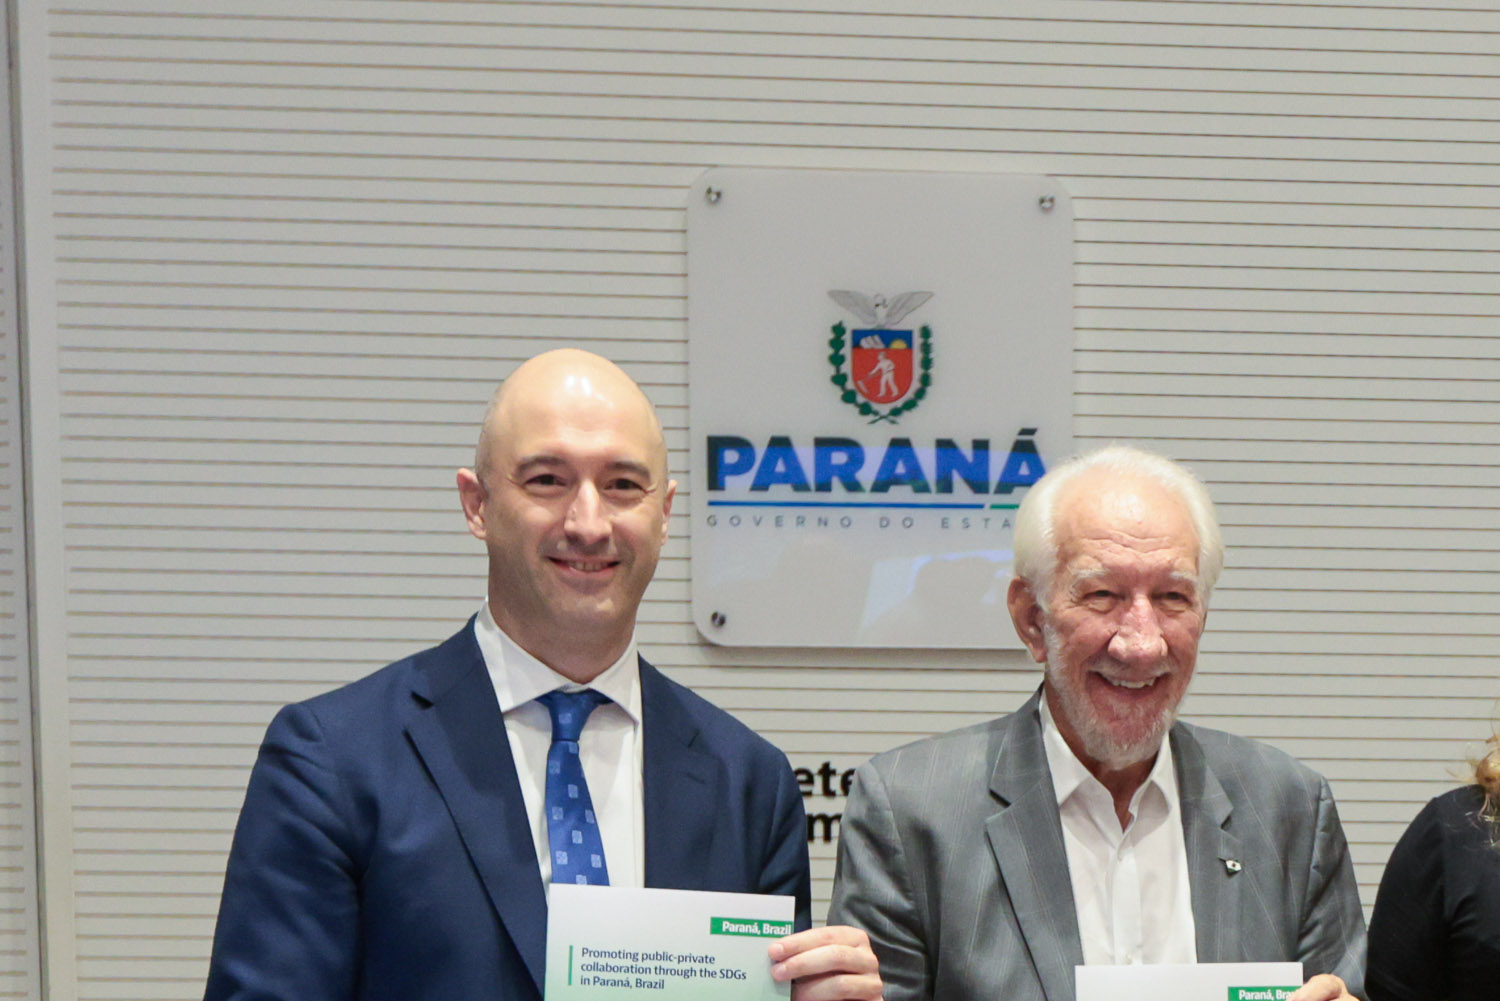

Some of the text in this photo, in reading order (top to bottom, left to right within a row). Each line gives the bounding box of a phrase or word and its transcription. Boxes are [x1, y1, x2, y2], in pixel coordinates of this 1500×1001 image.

[706, 428, 1046, 494] PARANÁ
[707, 515, 1011, 530] GOVERNO DO ESTA
[722, 921, 792, 936] Paraná, Brazil
[581, 948, 716, 965] Promoting public-private
[581, 962, 747, 980] collaboration through the SDGs
[580, 976, 665, 990] in Paraná, Brazil
[1239, 989, 1274, 1001] Paraná,
